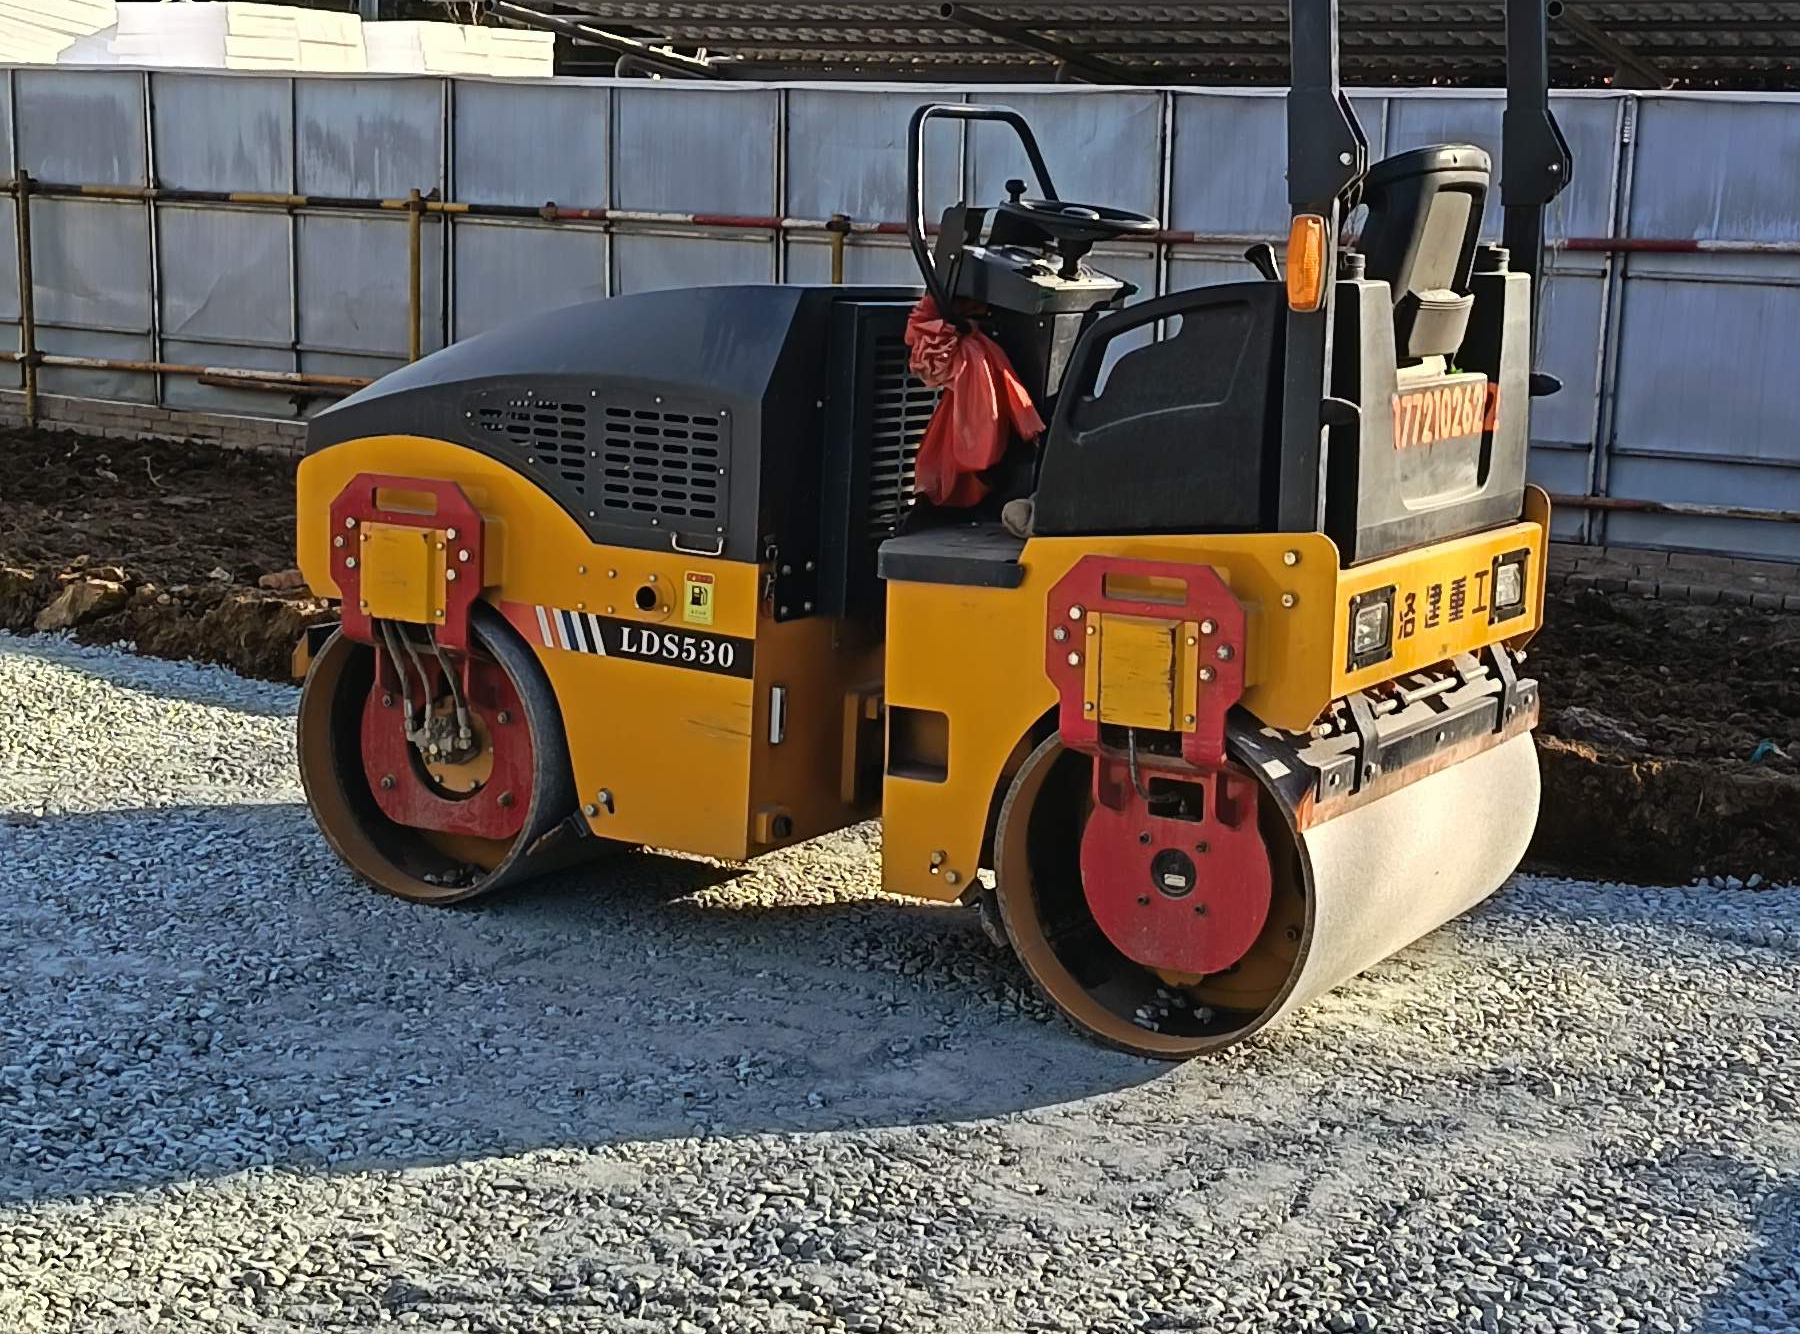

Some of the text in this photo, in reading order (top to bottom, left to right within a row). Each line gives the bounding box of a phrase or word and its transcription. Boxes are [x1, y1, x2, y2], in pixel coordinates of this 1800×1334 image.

[1398, 569, 1489, 640] 洛建重工
[620, 626, 734, 668] LDS530
